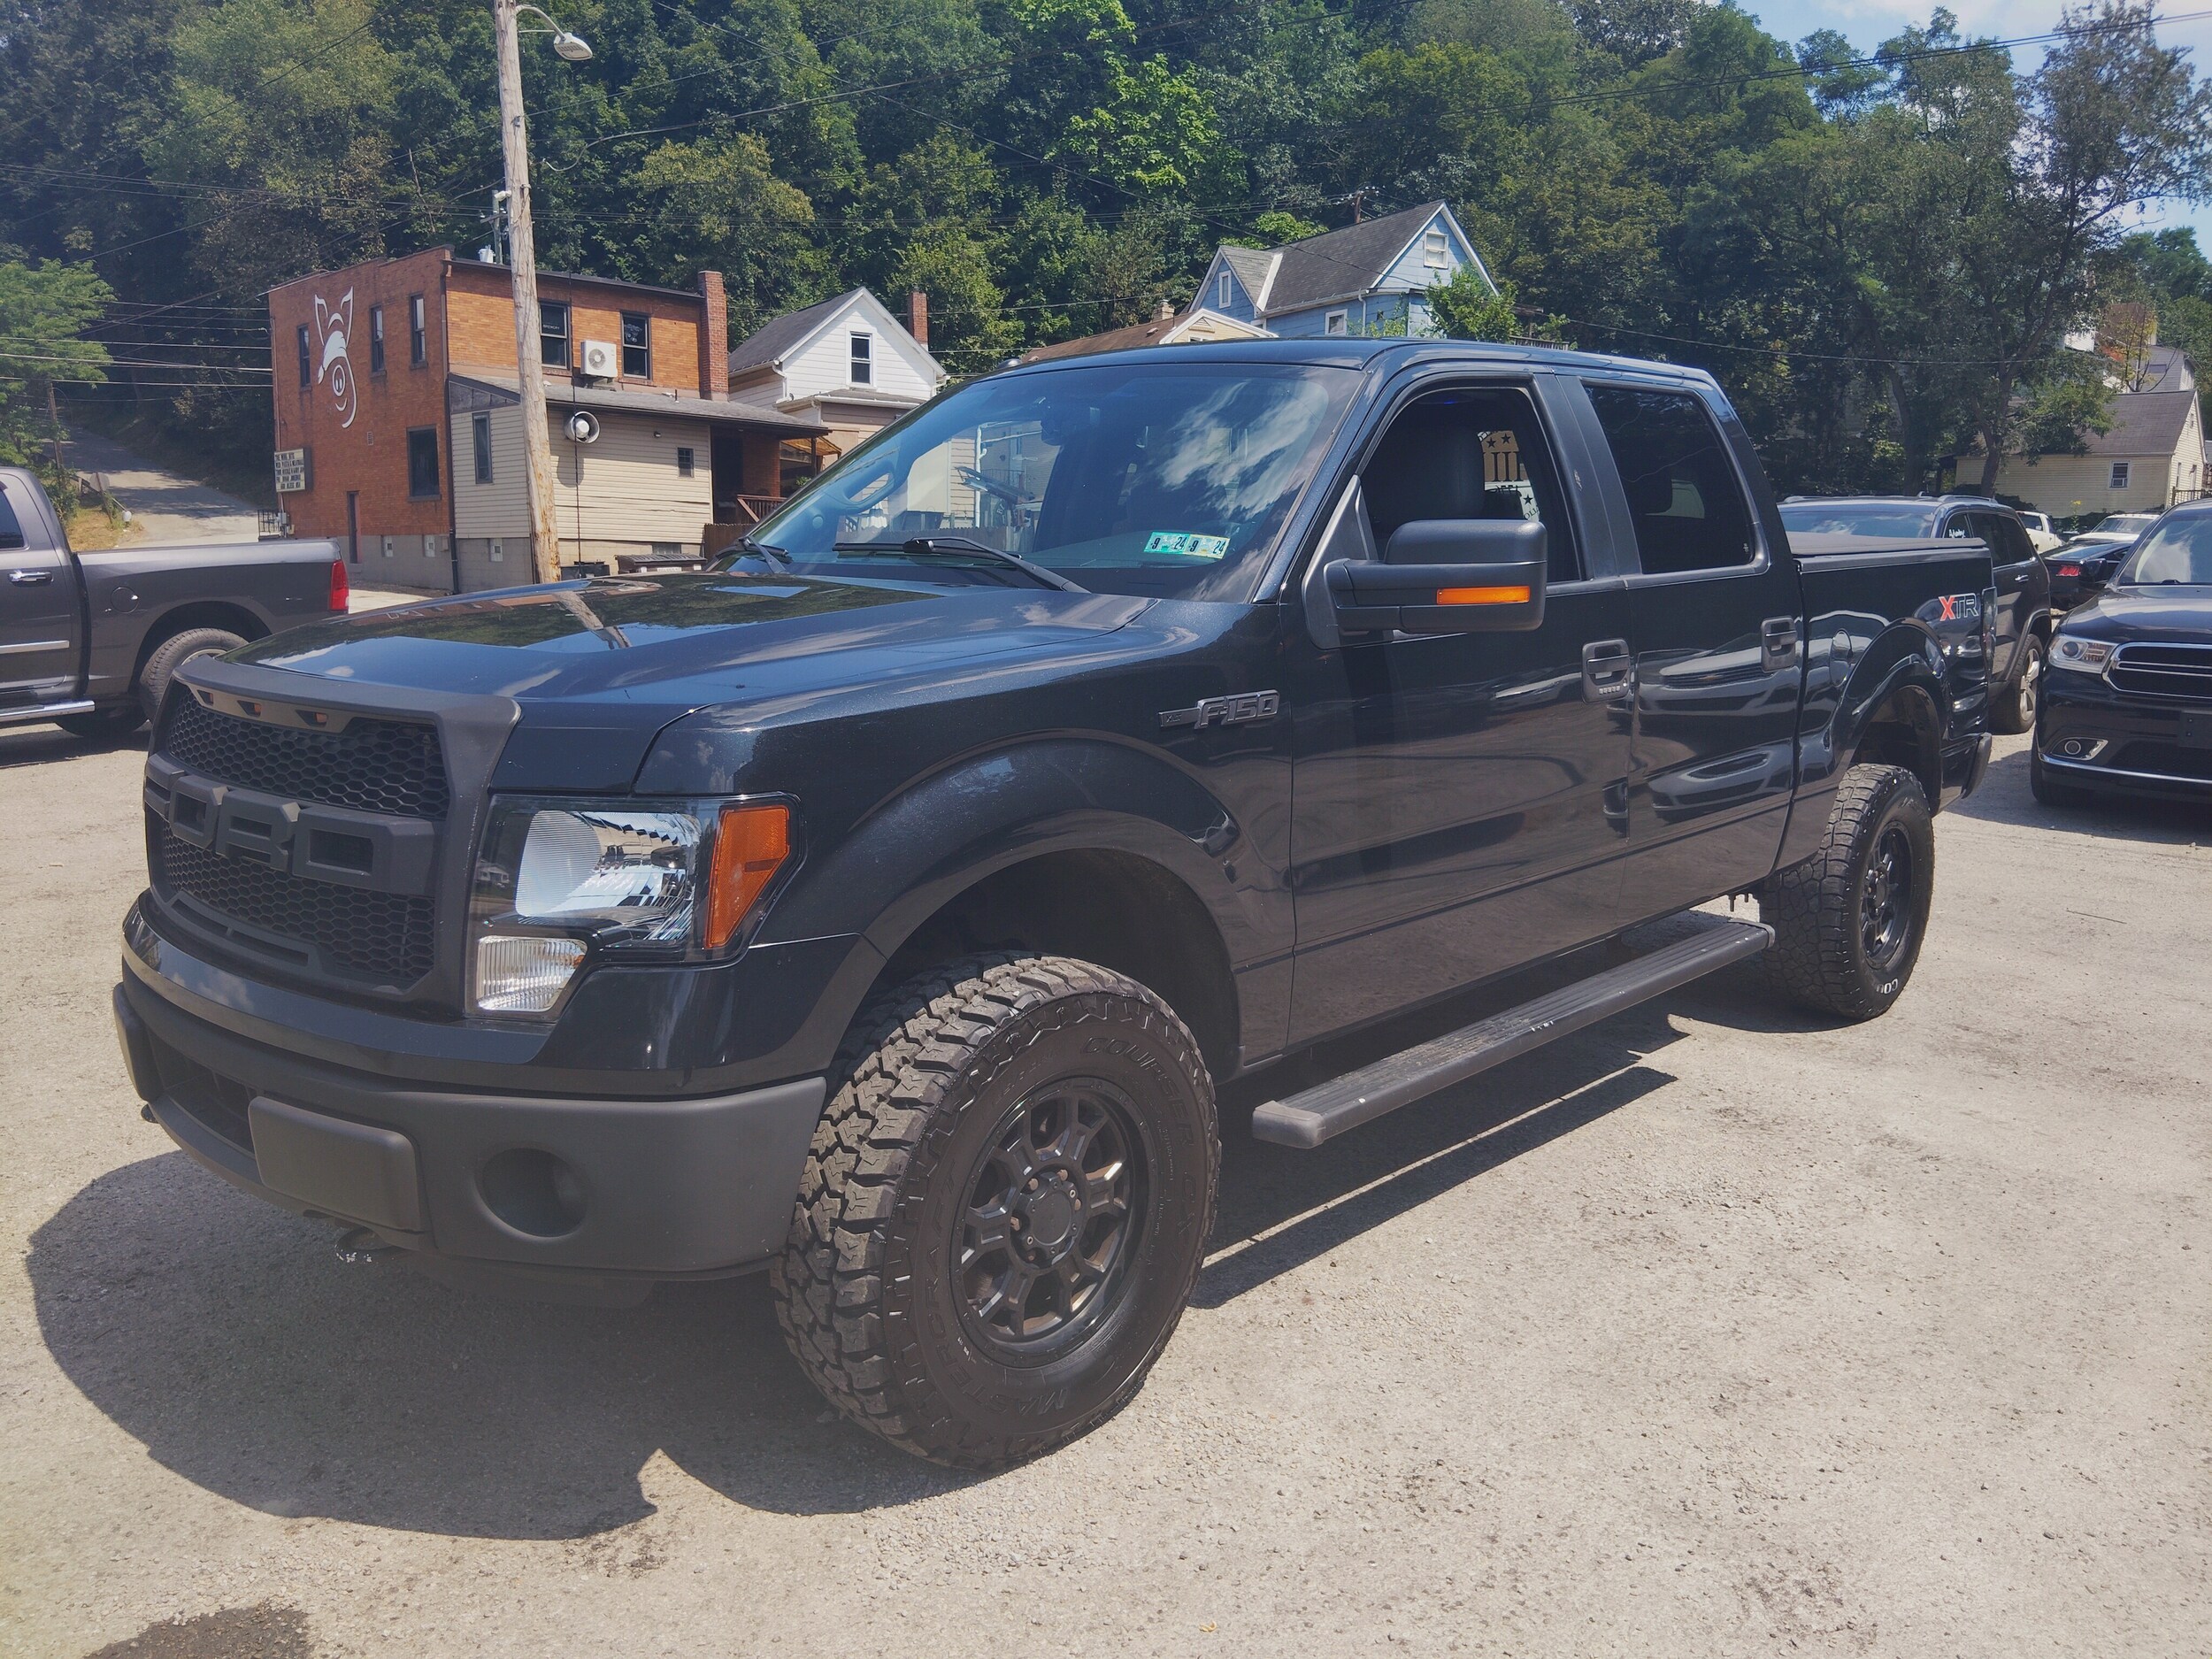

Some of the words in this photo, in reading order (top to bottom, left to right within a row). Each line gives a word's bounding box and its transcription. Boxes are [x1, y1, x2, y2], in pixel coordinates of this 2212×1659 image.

[1174, 536, 1187, 549] 24
[1213, 541, 1226, 554] 24
[1939, 593, 1979, 621] XTR
